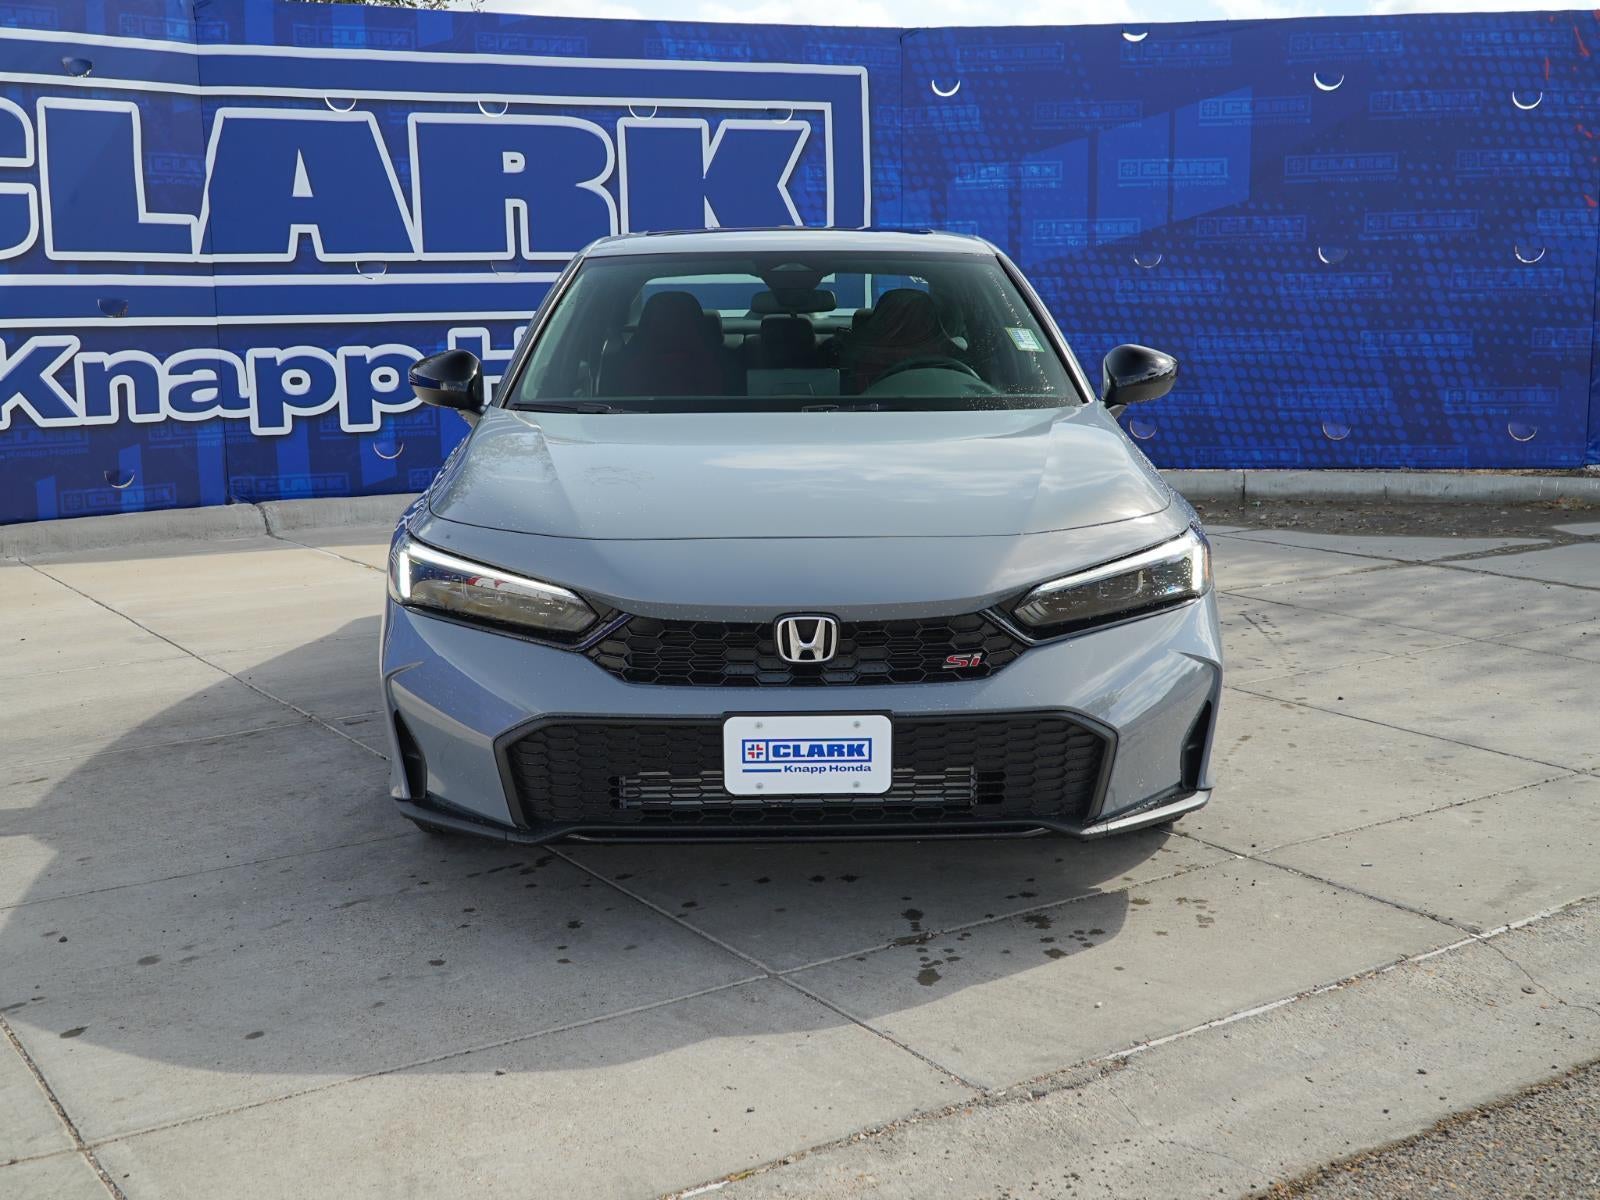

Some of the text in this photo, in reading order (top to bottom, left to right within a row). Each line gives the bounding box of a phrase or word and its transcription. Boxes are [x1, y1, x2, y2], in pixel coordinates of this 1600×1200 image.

[0, 97, 811, 262] LARK
[943, 653, 982, 668] Si
[771, 743, 867, 758] CLARK
[784, 764, 872, 774] Knapp Honda
